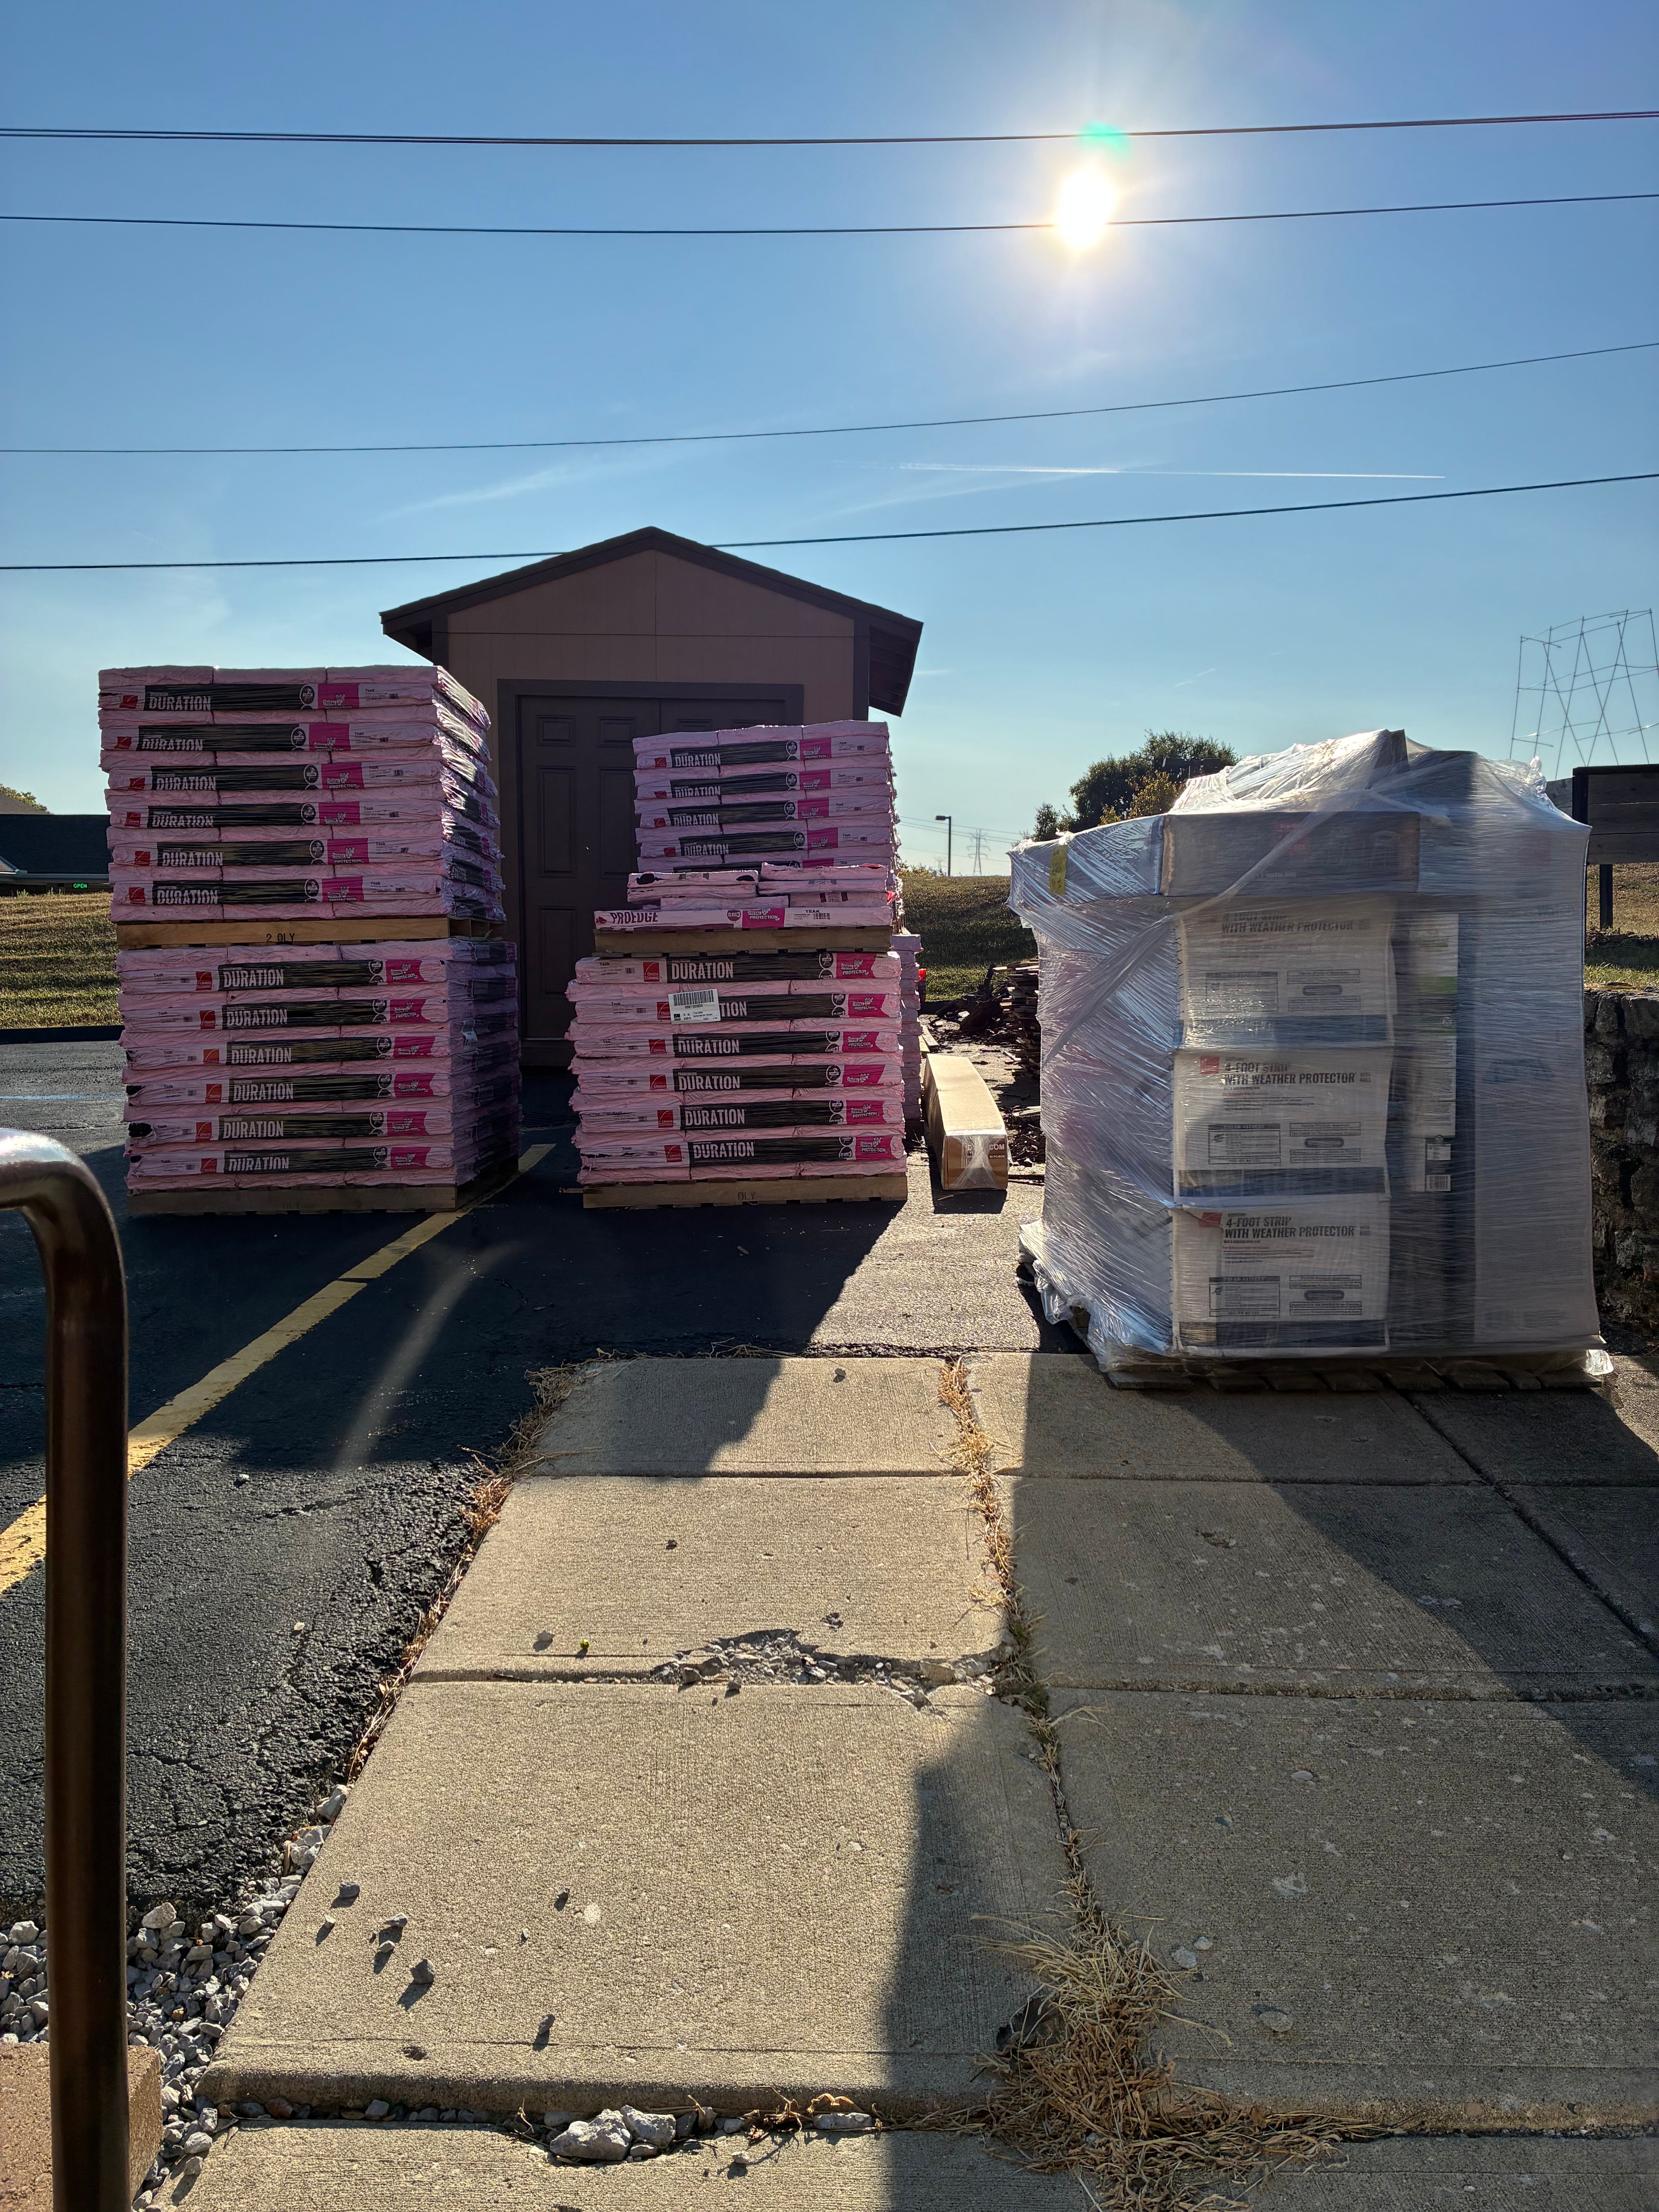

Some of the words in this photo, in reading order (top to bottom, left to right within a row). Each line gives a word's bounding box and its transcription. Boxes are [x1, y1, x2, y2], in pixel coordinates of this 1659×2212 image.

[149, 696, 211, 711] DURATION
[141, 738, 203, 751] DURATION
[675, 753, 721, 767] DURATION
[156, 776, 216, 791] DURATION
[152, 815, 213, 828] DURATION
[162, 851, 223, 866] DURATION
[157, 890, 218, 905] DURATION
[610, 912, 658, 924] PROEDGE
[1249, 922, 1294, 932] WEATHER
[266, 933, 271, 942] 2
[223, 969, 284, 988] DURATION
[672, 962, 733, 980] DURATION
[227, 1009, 288, 1027] DURATION
[678, 1039, 740, 1054] DURATION
[232, 1048, 292, 1064] DURATION
[679, 1075, 740, 1091] DURATION
[1252, 1073, 1296, 1085] WEATHER
[1299, 1072, 1355, 1084] PROTECTOR
[233, 1083, 294, 1101] DURATION
[685, 1108, 745, 1126] DURATION
[223, 1121, 284, 1139] DURATION
[694, 1142, 755, 1159] DURATION
[228, 1156, 289, 1172] DURATION
[1226, 1217, 1261, 1228] 4-FOOT
[1263, 1216, 1291, 1226] STRIP
[1225, 1228, 1249, 1238] WITH
[1252, 1227, 1296, 1238] WEATHER
[1299, 1226, 1355, 1237] PROTECTOR
